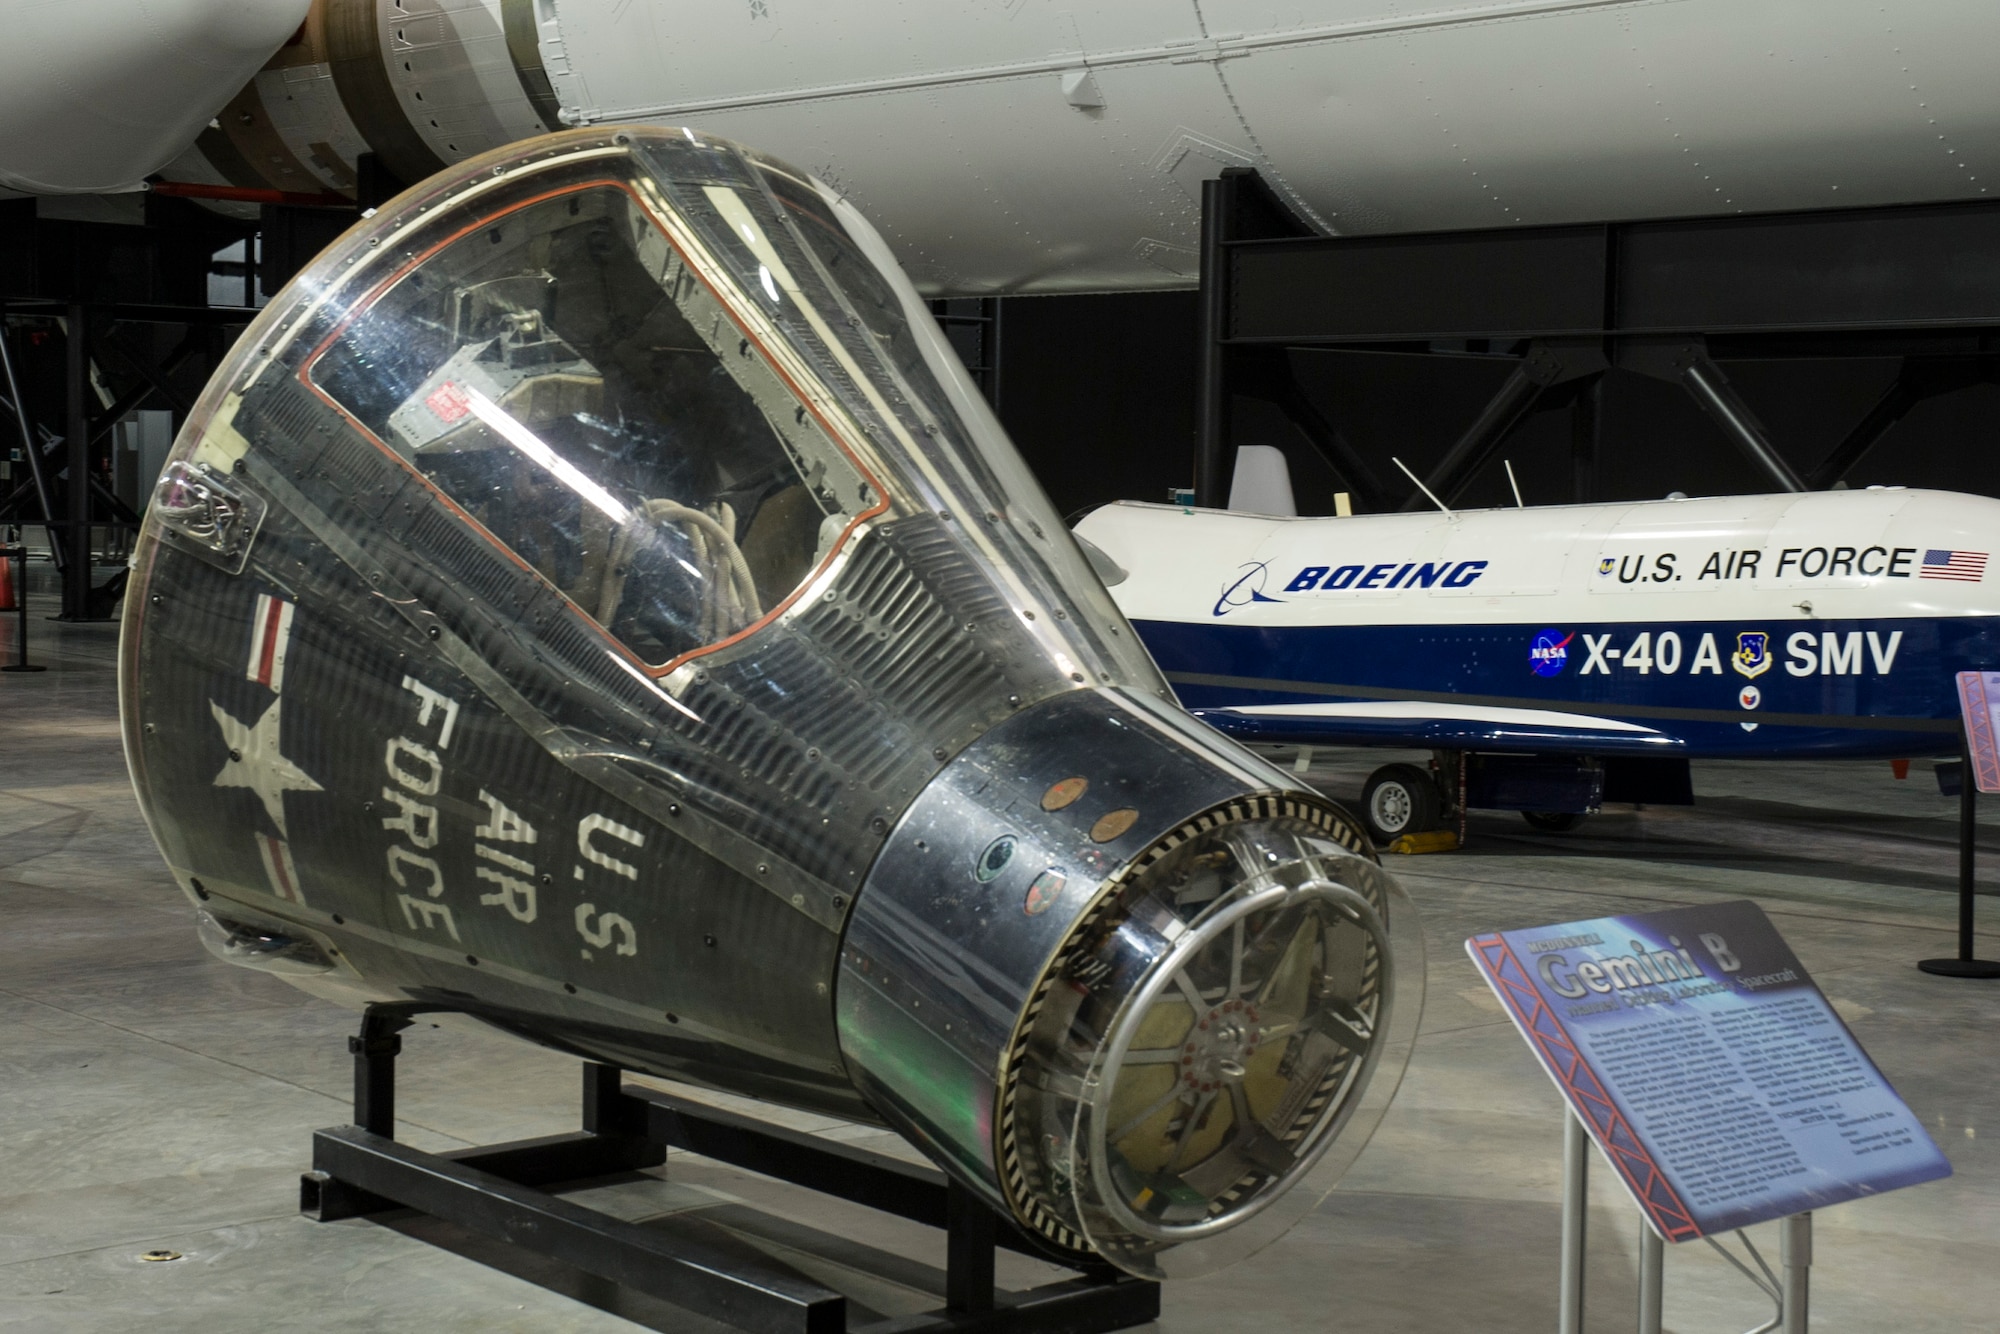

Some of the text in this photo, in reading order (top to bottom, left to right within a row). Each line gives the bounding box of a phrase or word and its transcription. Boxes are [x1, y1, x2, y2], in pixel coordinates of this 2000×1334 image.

[1282, 560, 1489, 592] BOEING
[1617, 546, 1917, 584] U.S. AIR FORCE
[1530, 647, 1567, 660] NASA
[1784, 630, 1903, 677] SMV
[381, 674, 462, 944] FORCE
[474, 788, 538, 924] AIR
[573, 812, 646, 962] U.S.
[1537, 931, 1742, 999] Gemini B
[1736, 967, 1798, 992] Spacecraft
